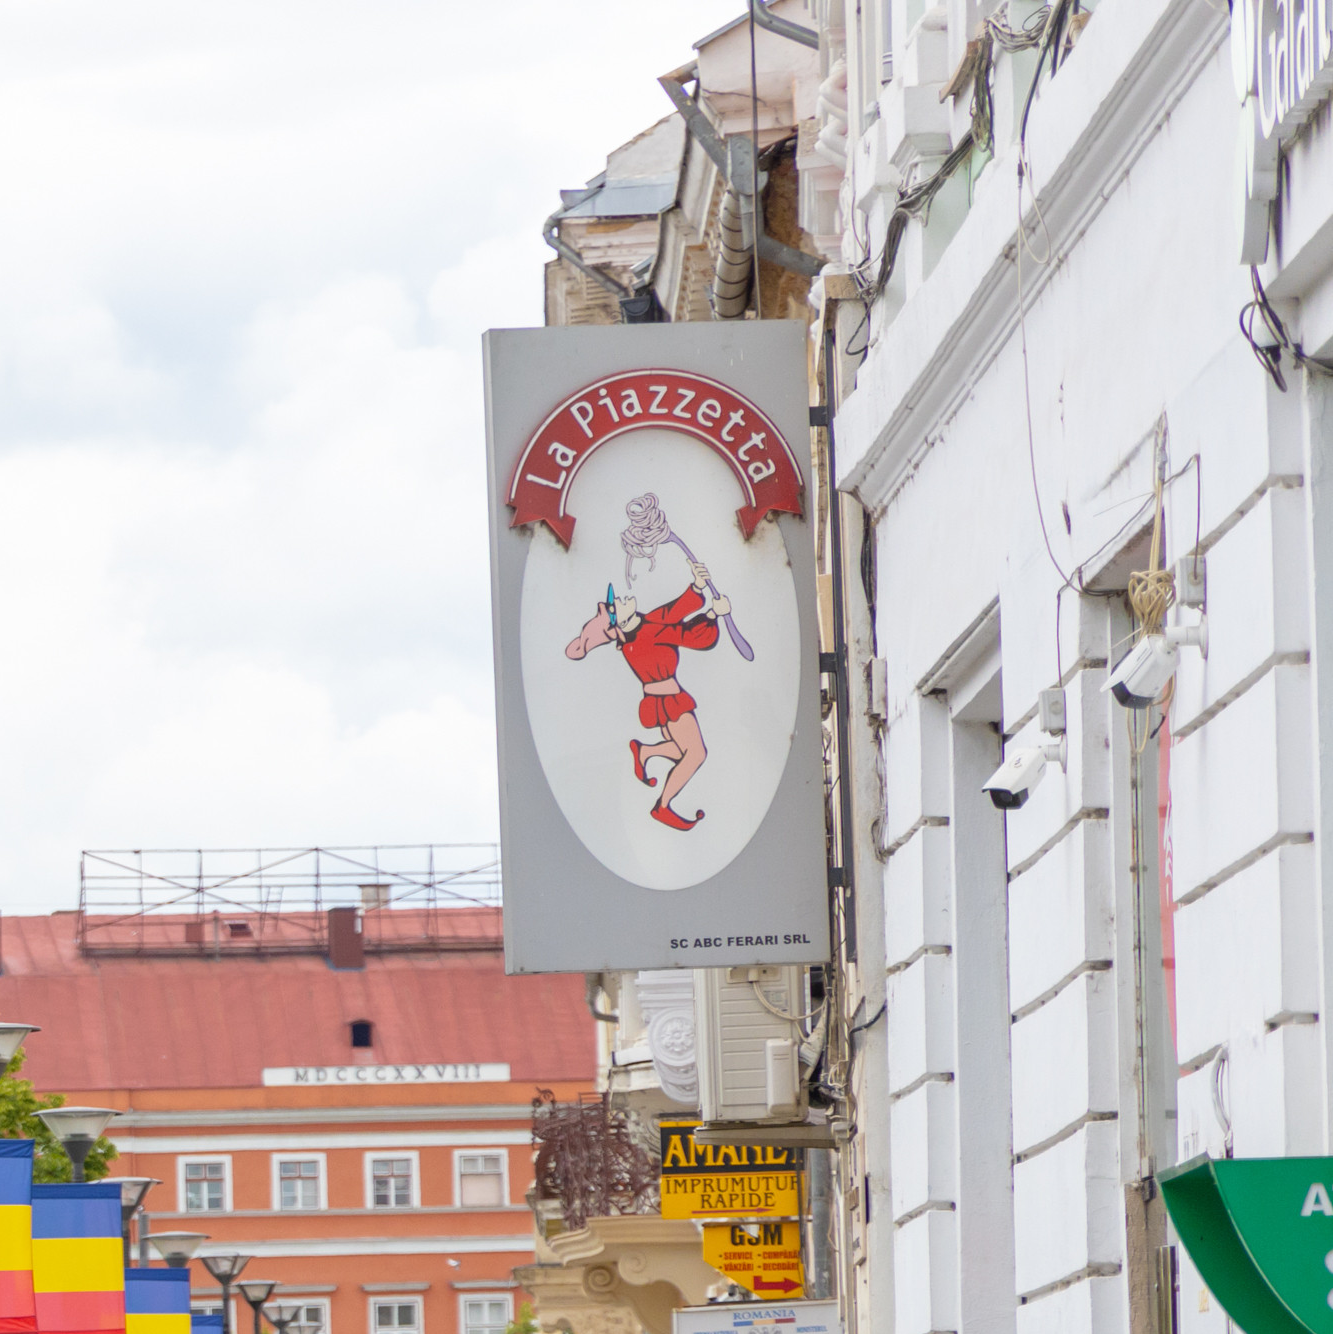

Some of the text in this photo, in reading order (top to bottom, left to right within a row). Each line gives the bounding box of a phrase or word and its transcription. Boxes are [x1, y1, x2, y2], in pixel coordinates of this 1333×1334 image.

[1258, 0, 1333, 139] Garant
[526, 385, 776, 490] La Piazzetta
[670, 934, 811, 949] SC ABC FERARI SRL
[663, 1134, 803, 1168] AMANE
[700, 1192, 776, 1209] RAPIDE
[1300, 1182, 1333, 1217] A
[733, 1309, 796, 1320] ROMANIA
